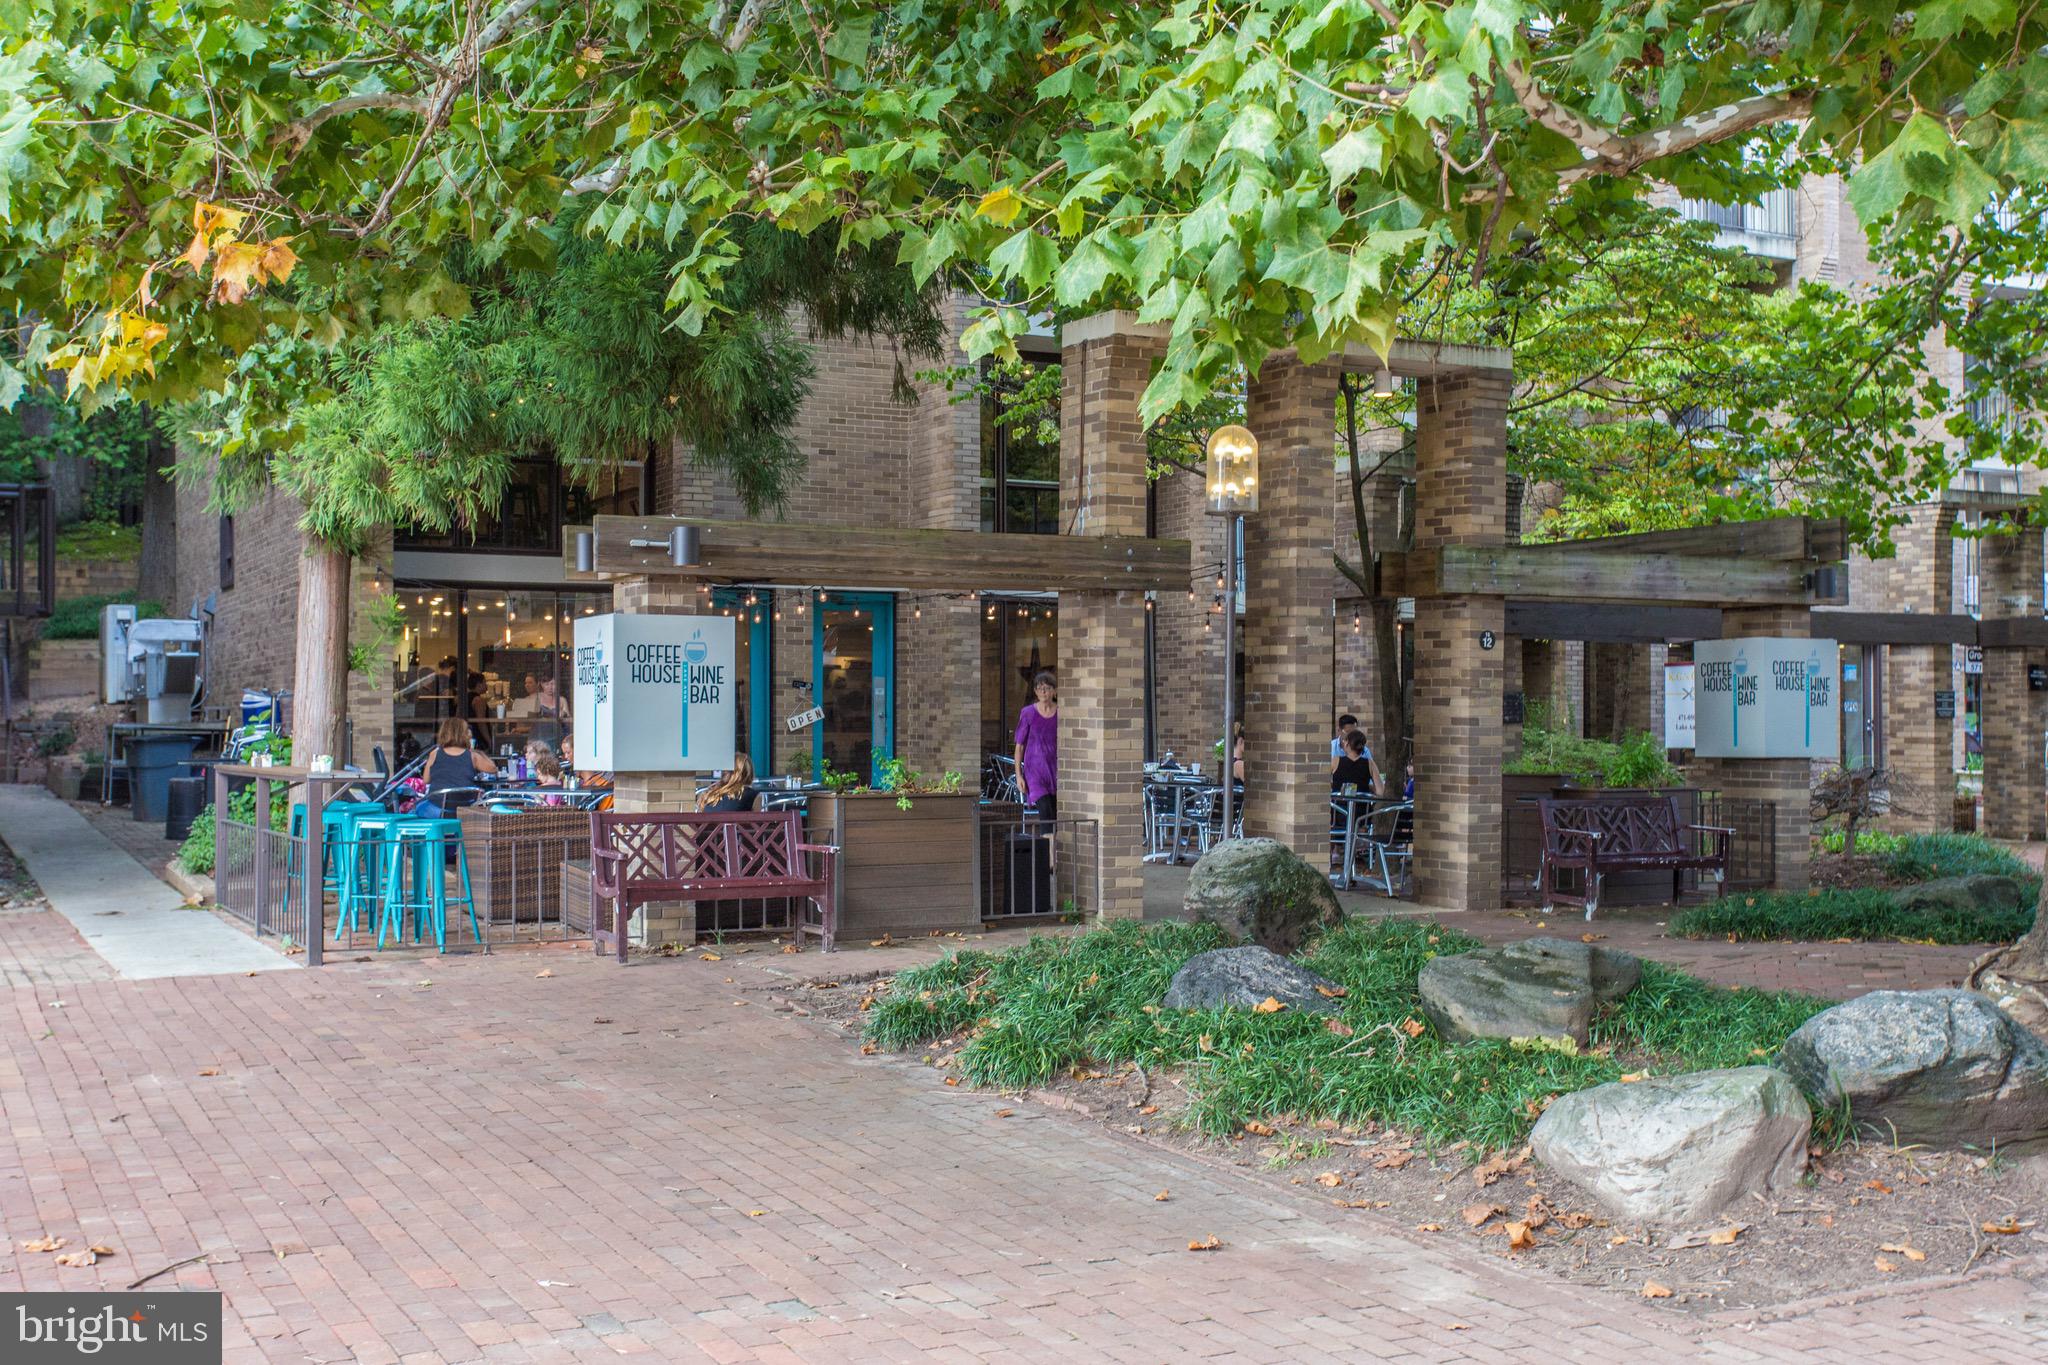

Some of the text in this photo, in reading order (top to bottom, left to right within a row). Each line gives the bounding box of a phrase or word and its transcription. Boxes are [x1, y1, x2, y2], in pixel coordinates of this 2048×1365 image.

[1482, 637, 1493, 648] 12
[577, 646, 595, 666] COFFEE
[626, 644, 681, 663] COFFEE
[579, 665, 595, 686] HOUSE
[632, 665, 681, 684] HOUSE
[690, 665, 724, 685] WINE
[1700, 661, 1732, 678] COFFEE
[1772, 660, 1805, 677] COFFEE
[1703, 677, 1732, 692] HOUSE
[1738, 676, 1758, 691] WINE
[1775, 677, 1805, 692] HOUSE
[1810, 677, 1831, 692] WINE
[597, 684, 608, 704] BAR
[690, 684, 720, 704] BAR
[1738, 691, 1756, 706] BAR
[1810, 692, 1828, 707] BAR
[789, 709, 822, 729] OPEN
